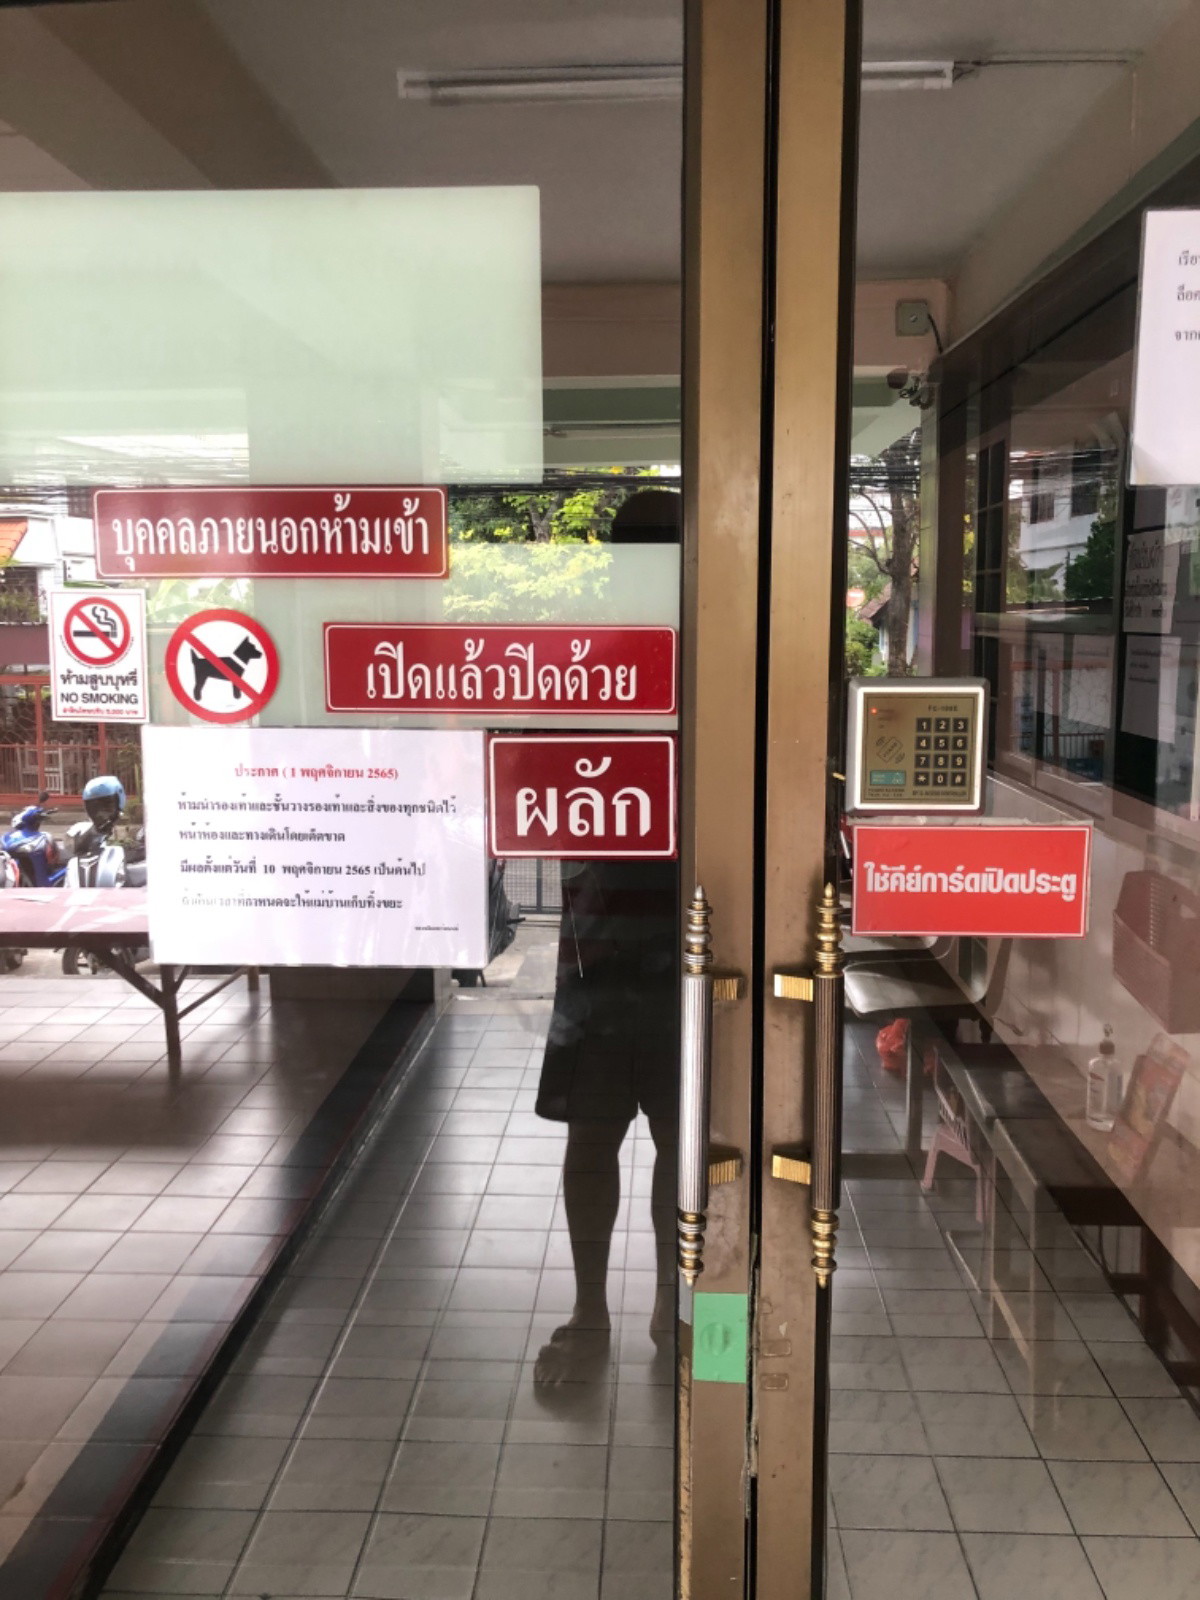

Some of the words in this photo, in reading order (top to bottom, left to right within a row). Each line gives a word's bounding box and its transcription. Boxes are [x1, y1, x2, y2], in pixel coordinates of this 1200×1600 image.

[1178, 250, 1200, 266] เรีย
[1174, 330, 1200, 341] จาก
[112, 493, 429, 572] บุคคลภายนอกห้ามเข้า
[367, 638, 638, 701] เปิดแล้วปิดด้วย
[60, 668, 138, 691] ห้ามสูบบุหรี่
[60, 692, 78, 703] NO
[81, 692, 138, 705] SMOKING
[922, 721, 927, 730] 1
[940, 720, 946, 730] 2
[958, 720, 965, 730] 3
[920, 739, 926, 747] 4
[939, 739, 945, 748] 5
[956, 739, 963, 747] 6
[920, 756, 926, 766] 7
[938, 756, 944, 766] 8
[956, 756, 963, 766] 9
[235, 763, 279, 777] ประกาศ
[300, 763, 364, 782] พฤศจิกายน
[367, 768, 399, 780] 2565)
[937, 774, 944, 783] 0
[515, 756, 652, 838] ผลัก
[180, 855, 256, 874] มีผลตั้งแต่วันที่
[263, 864, 276, 875] 10
[282, 861, 342, 879] พฤศจิกายน
[345, 865, 370, 876] 2565
[373, 857, 426, 877] เป็นต้นไป
[863, 861, 1077, 902] ใช้คีย์การ์ดเปิดประตู
